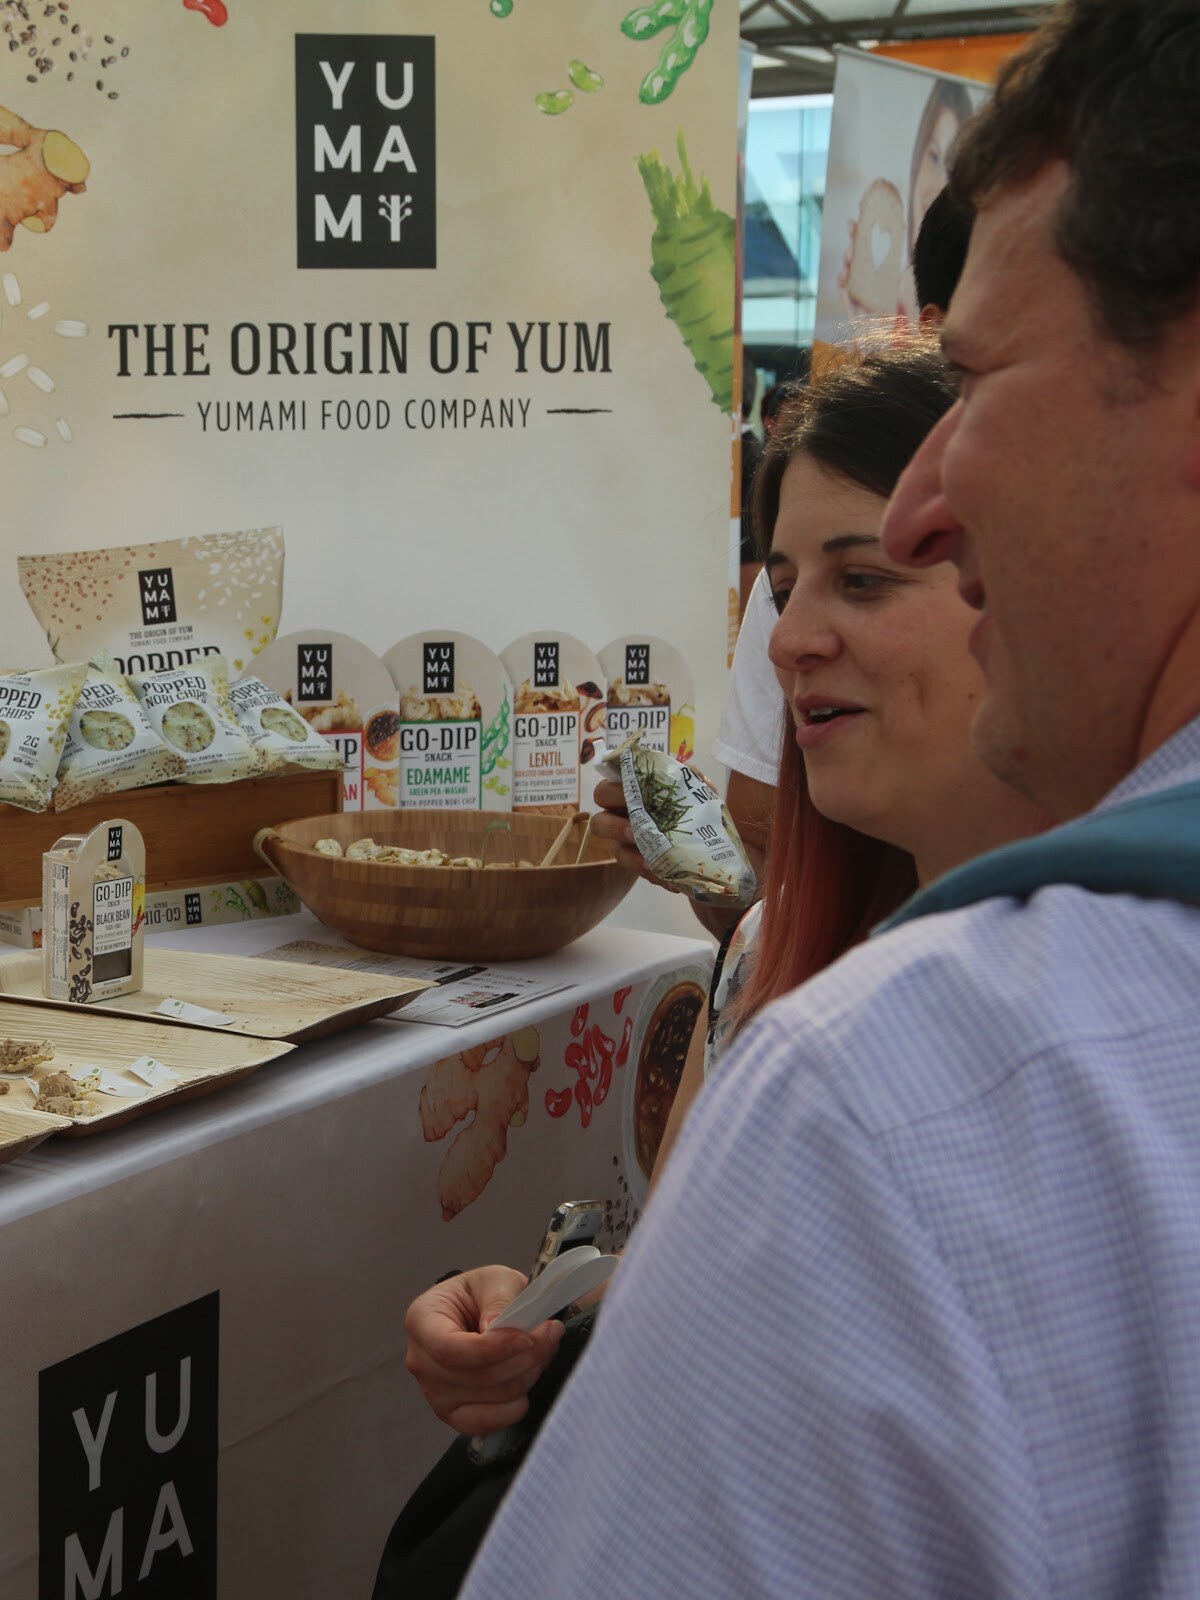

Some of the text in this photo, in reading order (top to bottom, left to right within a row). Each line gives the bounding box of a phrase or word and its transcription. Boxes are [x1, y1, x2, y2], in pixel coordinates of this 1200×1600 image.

[319, 61, 413, 109] YU
[314, 125, 417, 173] MA
[108, 322, 613, 377] THE ORIGIN OF YUM
[198, 398, 531, 432] YUMAMI FOOD COMPANY
[144, 574, 168, 588] YU
[144, 589, 170, 603] MA
[129, 632, 142, 640] THE
[144, 629, 167, 639] ORIGIN
[178, 625, 193, 634] YUM
[303, 650, 328, 663] YU
[428, 648, 450, 659] YU
[538, 647, 556, 657] YU
[301, 665, 328, 678] MA
[427, 661, 450, 673] MA
[537, 659, 556, 669] MA
[142, 676, 206, 697] POPPED
[88, 694, 123, 710] CHIPS
[145, 689, 208, 709] NORI CHIPS
[514, 715, 577, 738] GO-DIP
[608, 711, 666, 731] GO-DIP
[23, 735, 40, 749] 2G
[400, 726, 477, 752] GO-DIP
[535, 739, 558, 747] SNACK
[424, 752, 452, 762] SNACK
[529, 751, 563, 768] LENTIL
[406, 766, 471, 785] EDAMAME
[110, 830, 121, 838] YU
[696, 824, 718, 841] 100
[109, 839, 120, 848] MA
[95, 881, 132, 902] GO-DIP
[96, 908, 130, 925] BLACK BEAN
[72, 1355, 191, 1493] YU
